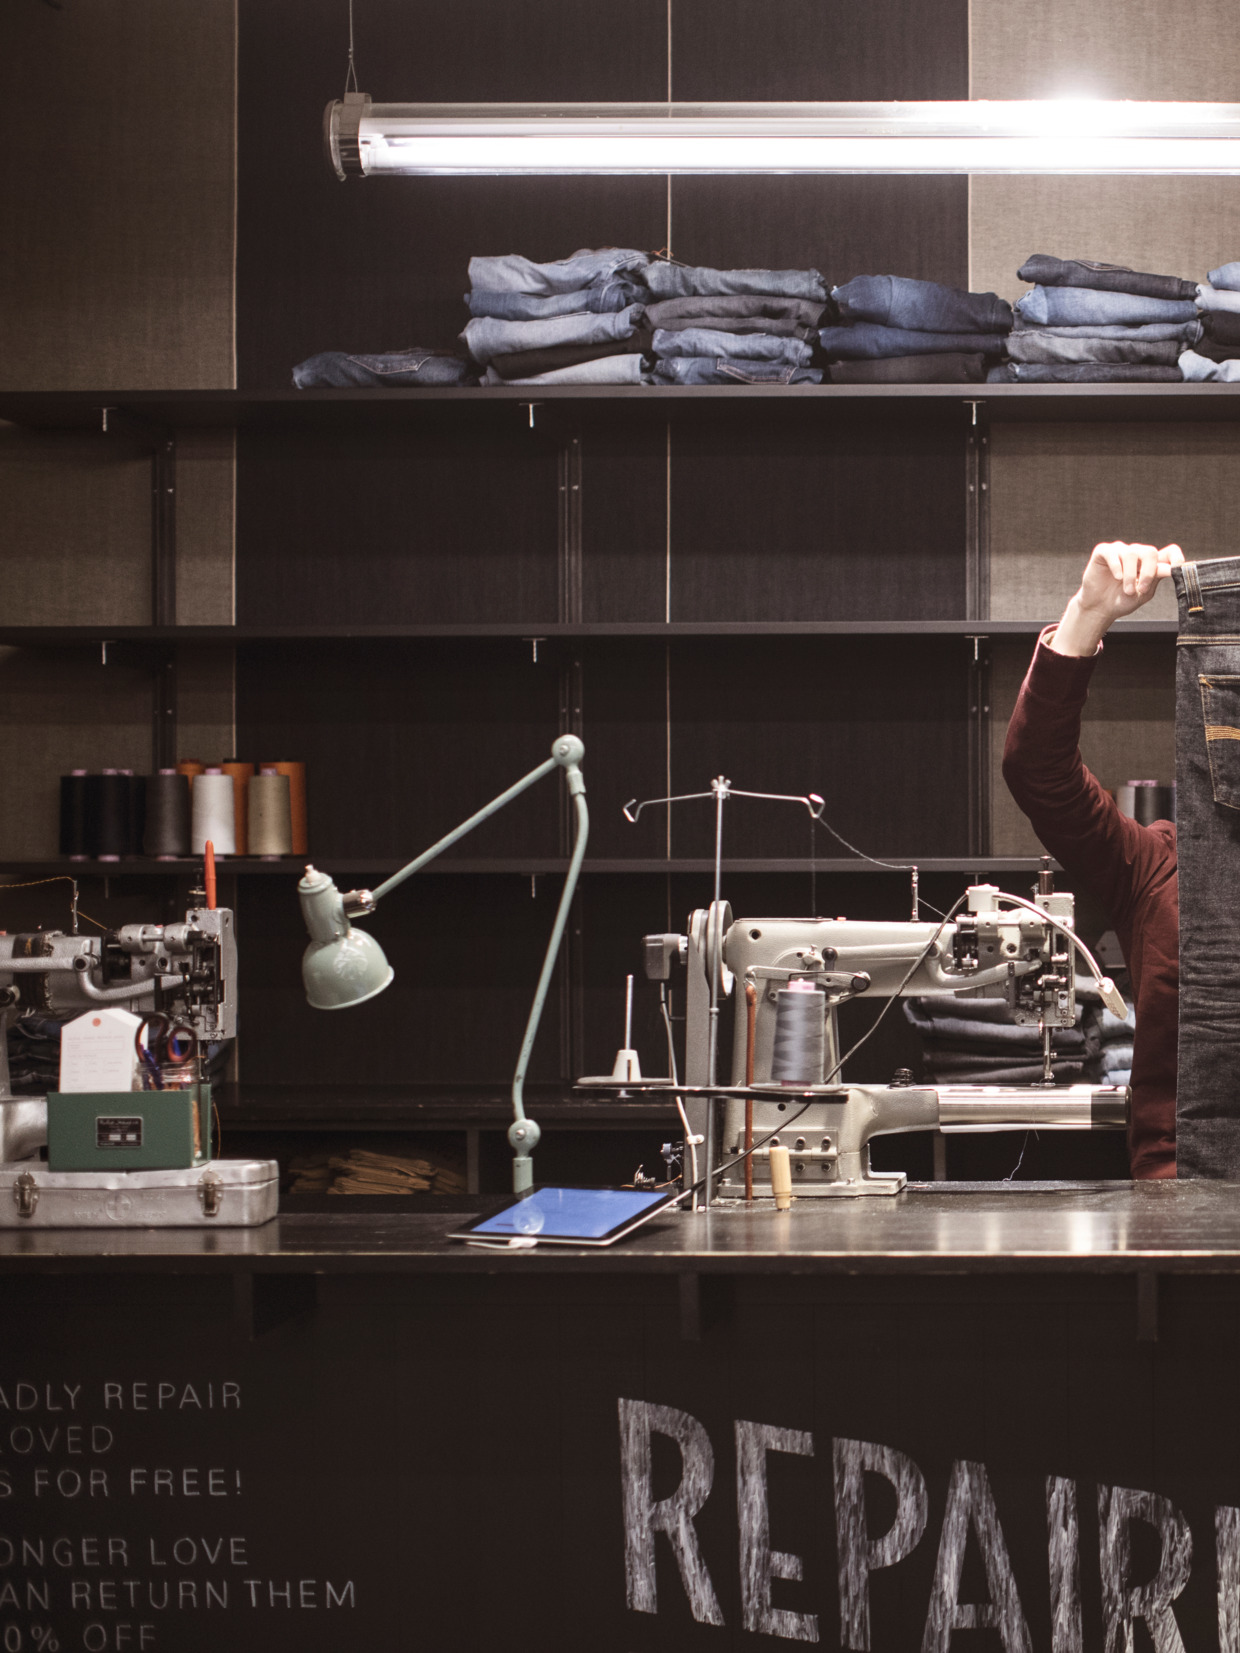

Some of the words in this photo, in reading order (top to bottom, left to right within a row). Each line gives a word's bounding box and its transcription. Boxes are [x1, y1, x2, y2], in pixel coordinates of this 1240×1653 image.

[104, 1381, 242, 1411] REPAIR
[0, 1425, 114, 1454] OVED
[34, 1468, 109, 1498] FOR
[129, 1467, 243, 1497] FREE!
[149, 1536, 248, 1566] LOVE
[71, 1580, 228, 1610] RETURN
[243, 1579, 356, 1609] THEM
[4, 1624, 60, 1653] 0%
[83, 1623, 155, 1653] OFF
